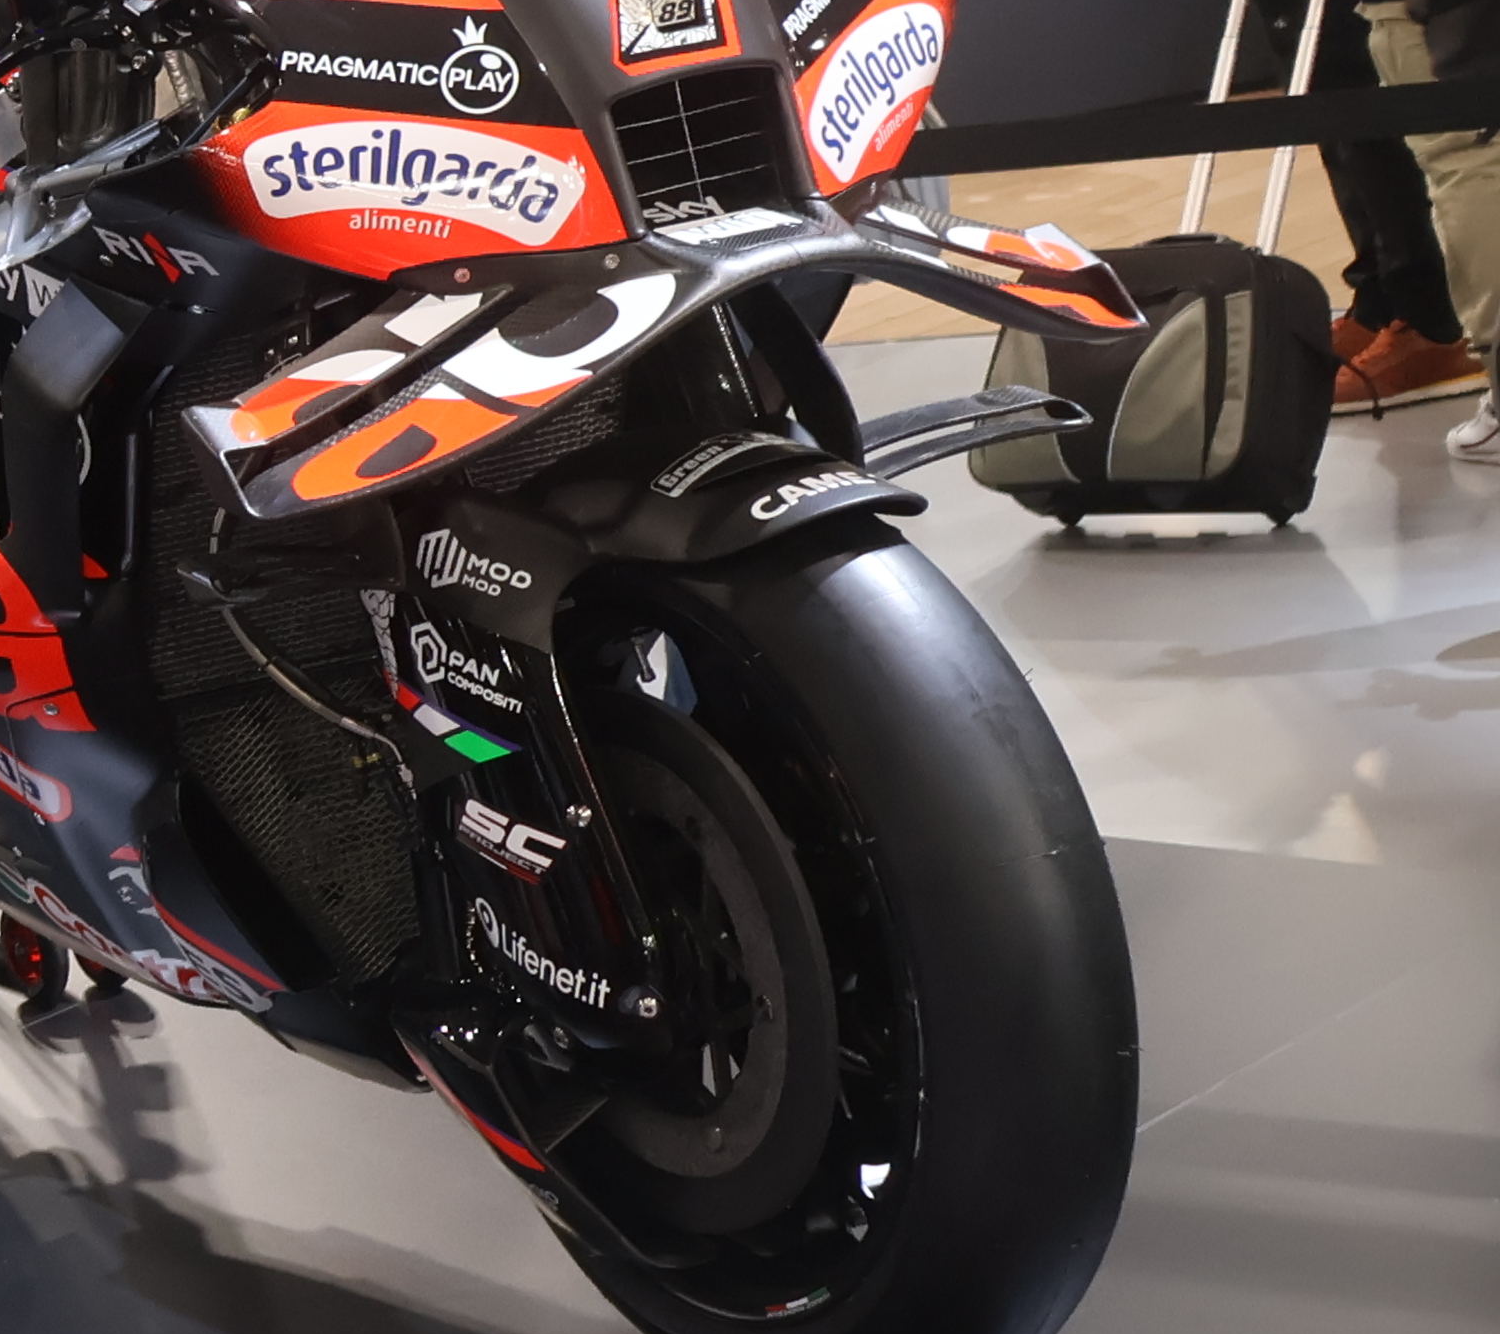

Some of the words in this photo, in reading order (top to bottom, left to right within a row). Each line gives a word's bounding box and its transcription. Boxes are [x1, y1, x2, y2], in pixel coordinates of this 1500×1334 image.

[280, 50, 439, 87] PRAGMATIC
[448, 67, 514, 94] PLAY
[821, 11, 939, 163] sterilgarda
[873, 98, 914, 153] alimenti
[263, 128, 560, 225] sterilgarda
[349, 209, 453, 240] alimenti
[641, 195, 726, 224] sky
[657, 443, 725, 490] Green
[750, 470, 877, 521] CAME
[461, 571, 502, 598] MOD
[466, 554, 533, 592] MOD
[447, 649, 501, 688] PAN
[447, 671, 524, 715] COMPOSITI
[460, 798, 567, 869] SC
[500, 922, 612, 1010] Lifenet.it
